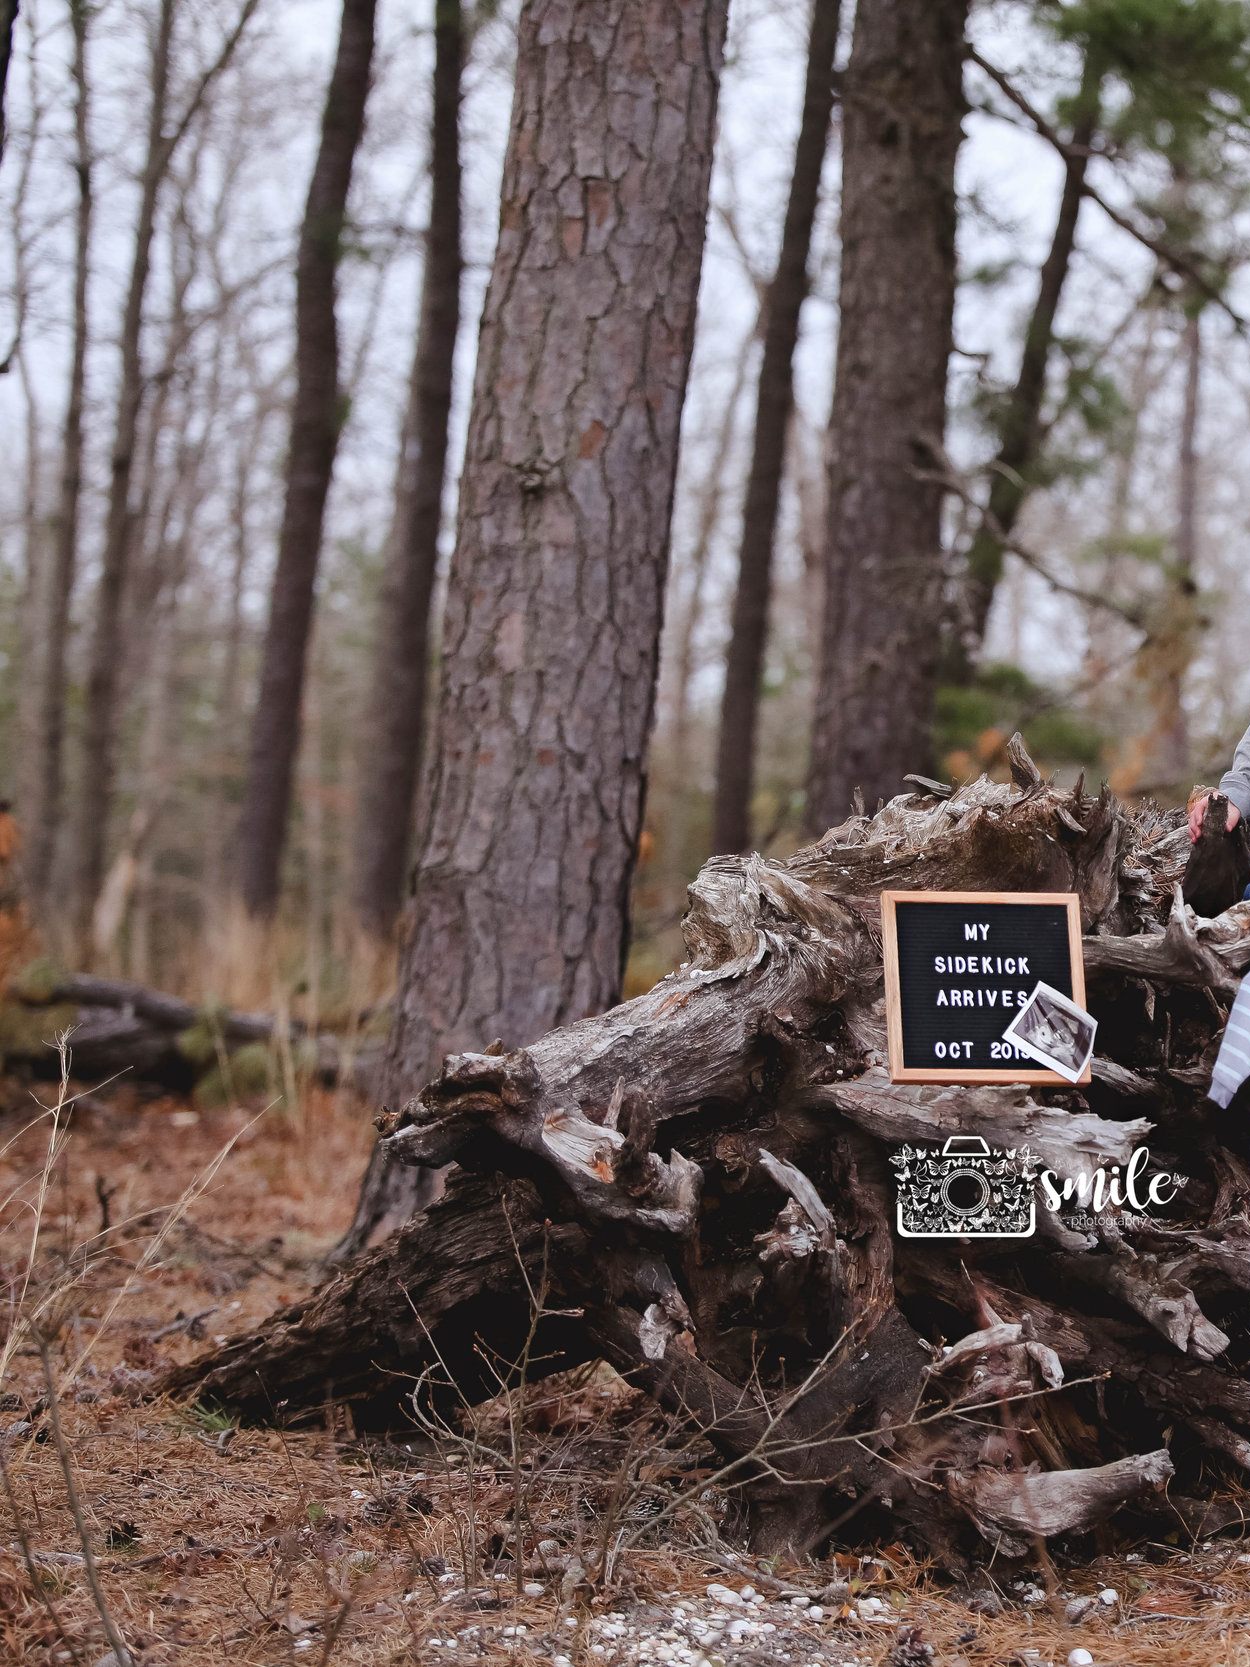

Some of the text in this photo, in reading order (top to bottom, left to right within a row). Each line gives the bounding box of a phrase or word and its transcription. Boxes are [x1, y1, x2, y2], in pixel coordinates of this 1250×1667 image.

[964, 924, 990, 941] MY
[934, 956, 1030, 975] SIDEKICK
[936, 990, 1028, 1007] ARRIVES
[934, 1041, 973, 1059] OCT
